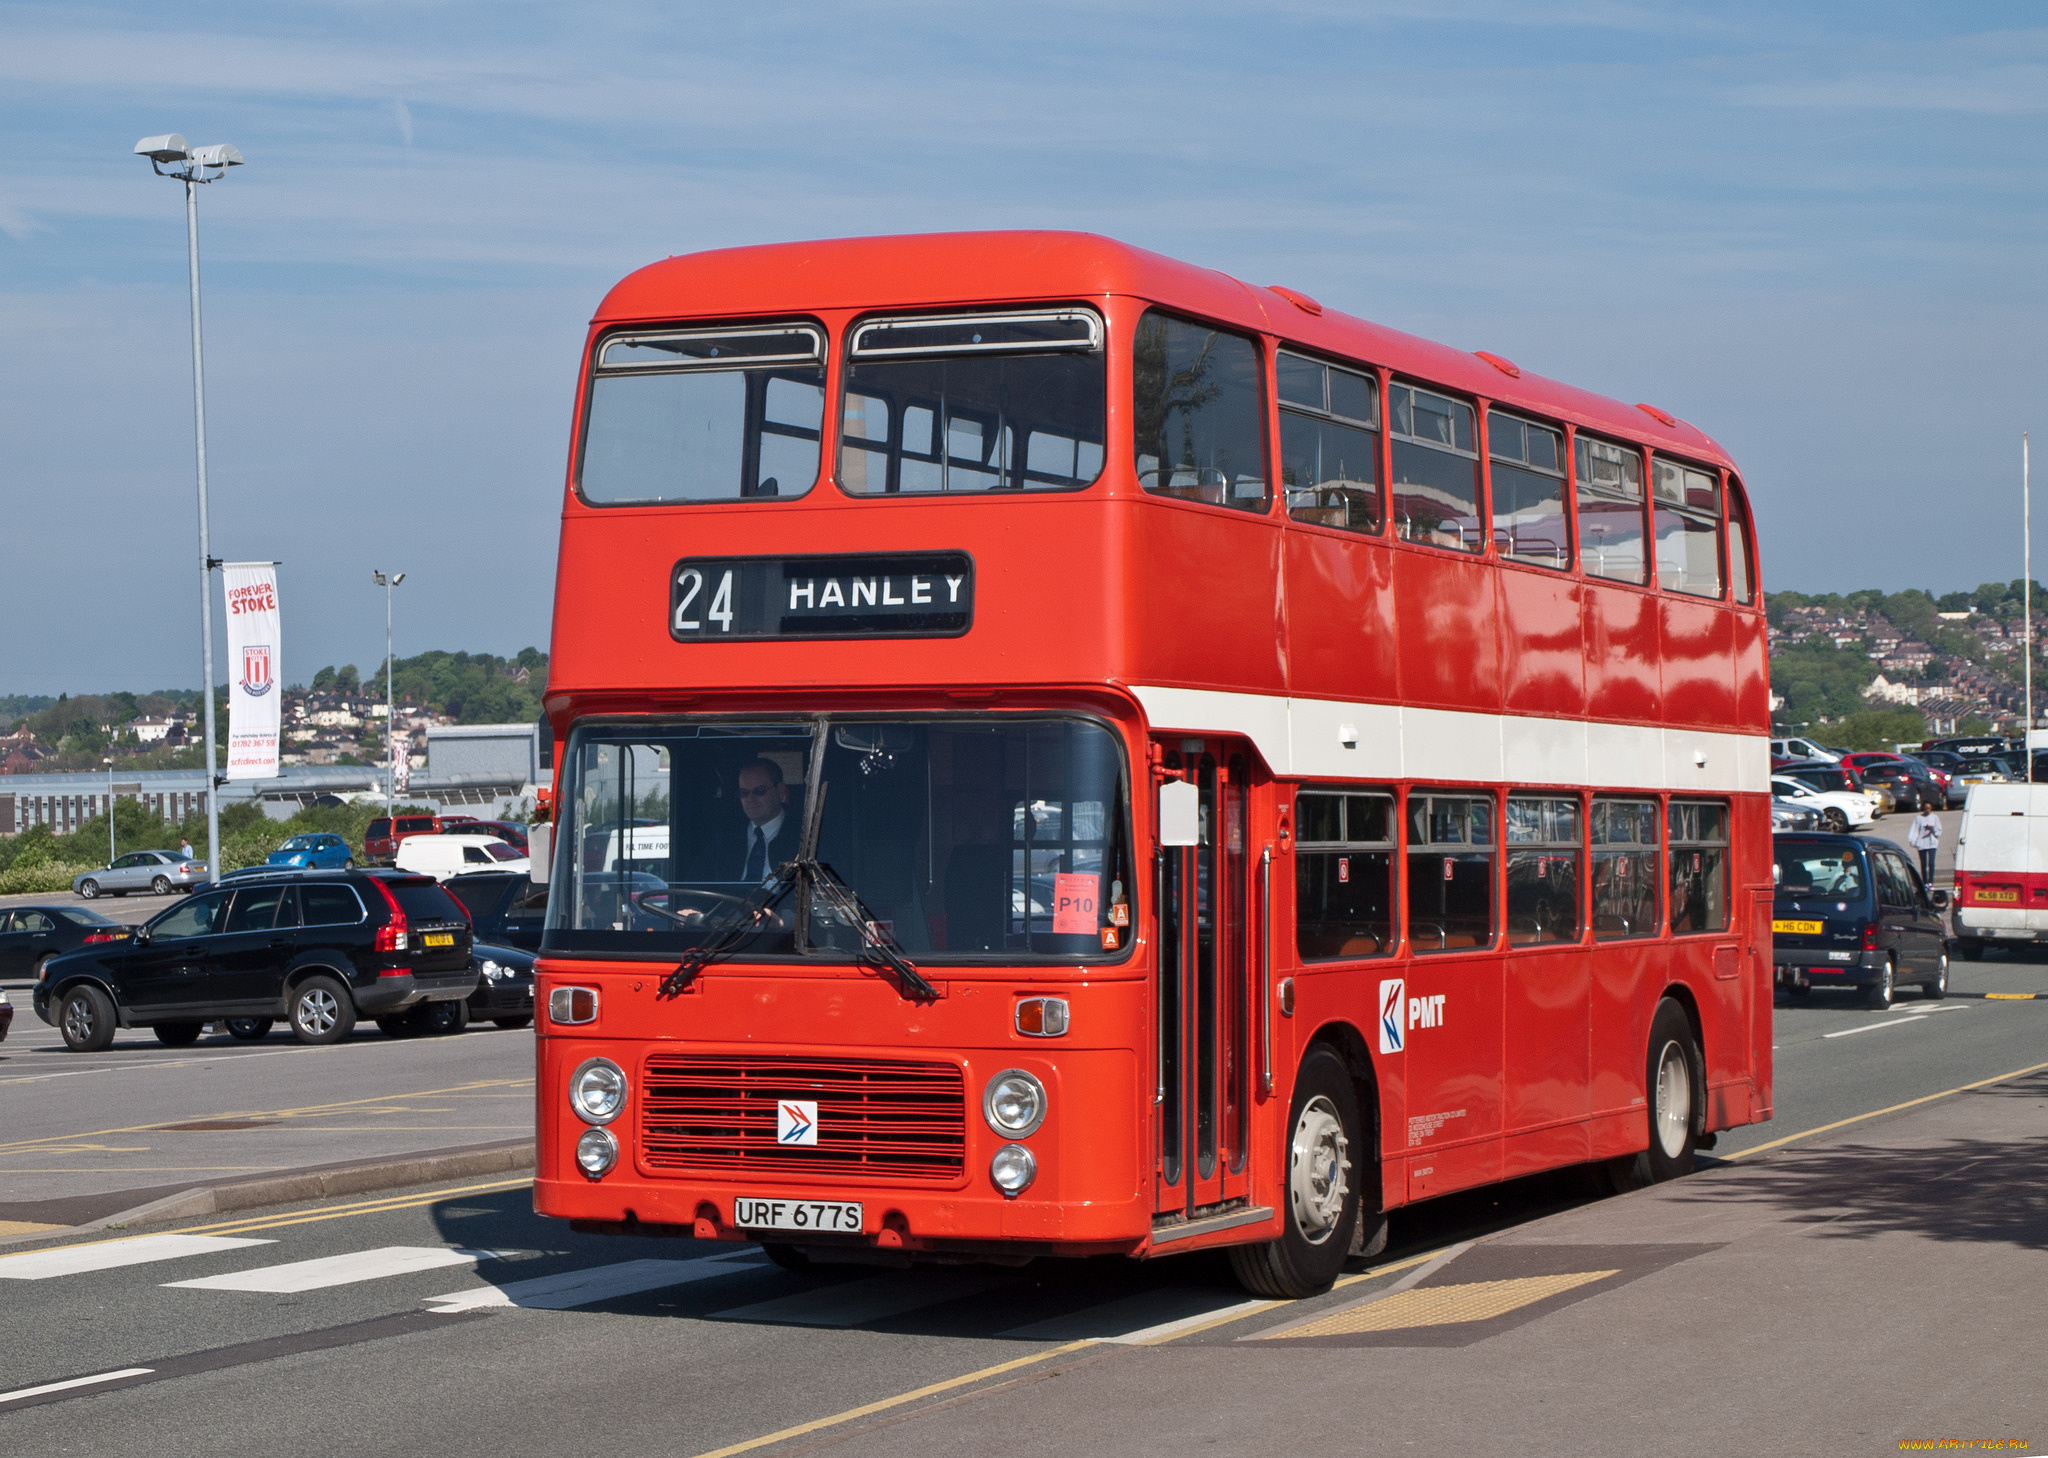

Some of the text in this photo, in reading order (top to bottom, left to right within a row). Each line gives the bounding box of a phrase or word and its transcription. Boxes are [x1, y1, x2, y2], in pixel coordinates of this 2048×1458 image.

[228, 583, 273, 600] FOREVER
[675, 568, 965, 632] 24 HANLEY
[231, 595, 276, 615] STOKE
[245, 648, 268, 656] STOKE
[1059, 897, 1093, 913] P10
[1117, 907, 1126, 918] A
[1105, 932, 1116, 943] A
[1409, 994, 1446, 1030] PMT
[738, 1202, 859, 1229] URF 677S
